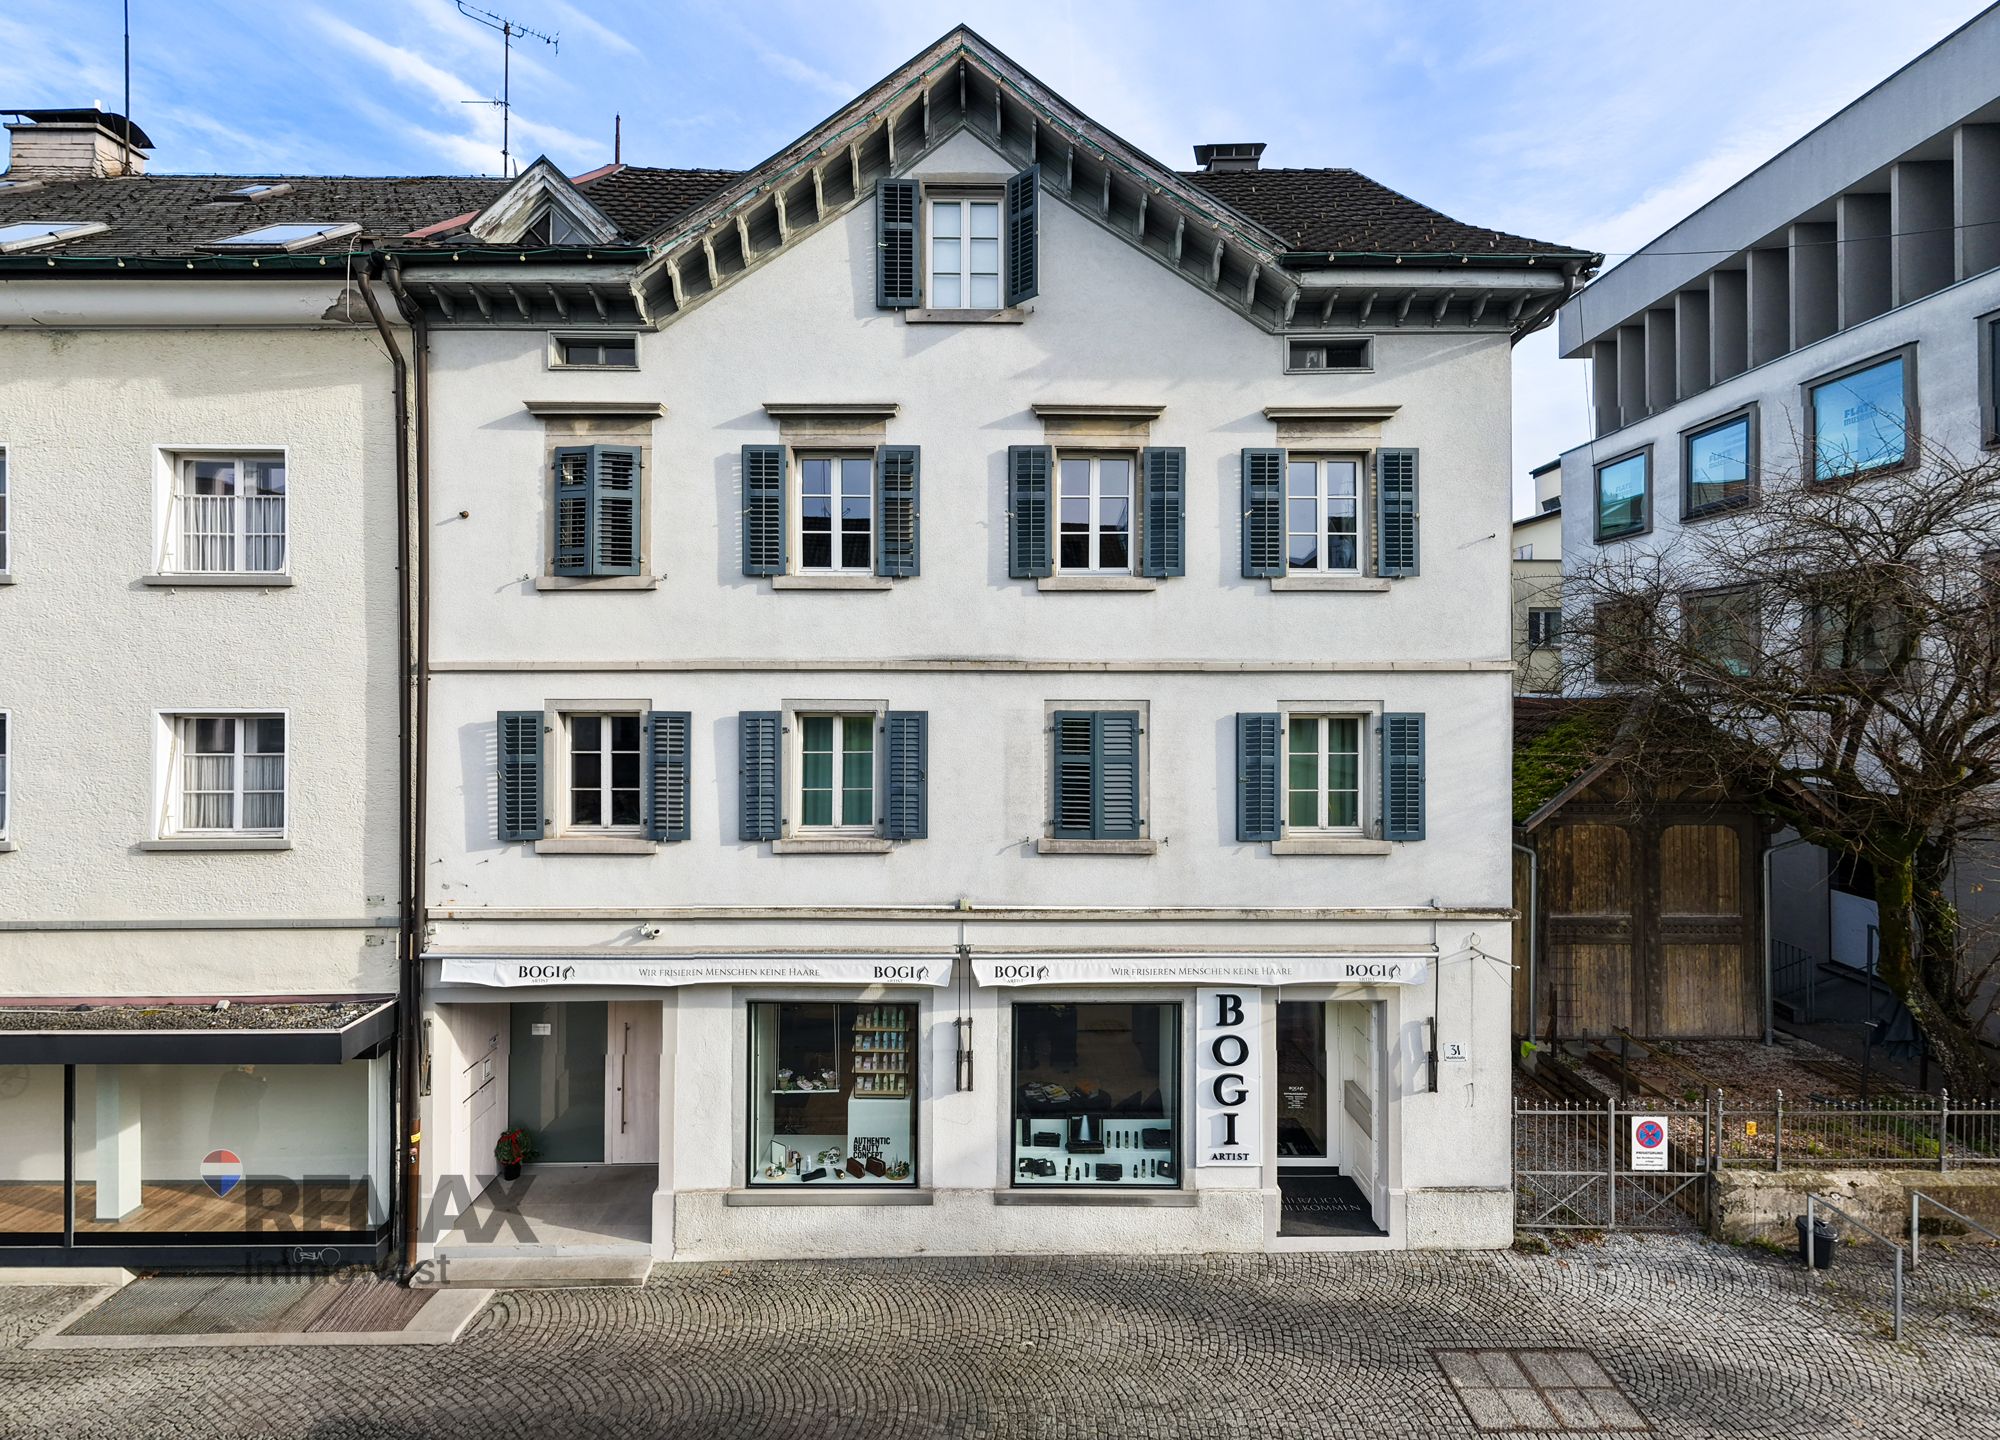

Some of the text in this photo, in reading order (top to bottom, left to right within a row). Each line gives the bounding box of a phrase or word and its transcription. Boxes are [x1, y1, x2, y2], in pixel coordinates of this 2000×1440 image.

[519, 965, 560, 978] BOGI
[705, 968, 758, 976] MENSCHEN
[760, 968, 786, 976] KEINE
[873, 966, 914, 978] BOGI
[994, 965, 1034, 978] BOGI
[1179, 967, 1231, 976] MENSCHEN
[1233, 967, 1259, 975] KEINE
[1346, 964, 1386, 976] BOGI
[1450, 1044, 1461, 1056] 31
[1211, 993, 1250, 1146] BOGI
[853, 1136, 891, 1145] AUTHENTIC
[853, 1144, 880, 1152] BEAUTY
[853, 1151, 883, 1159] CONCEPT
[1211, 1152, 1250, 1161] ARTIST
